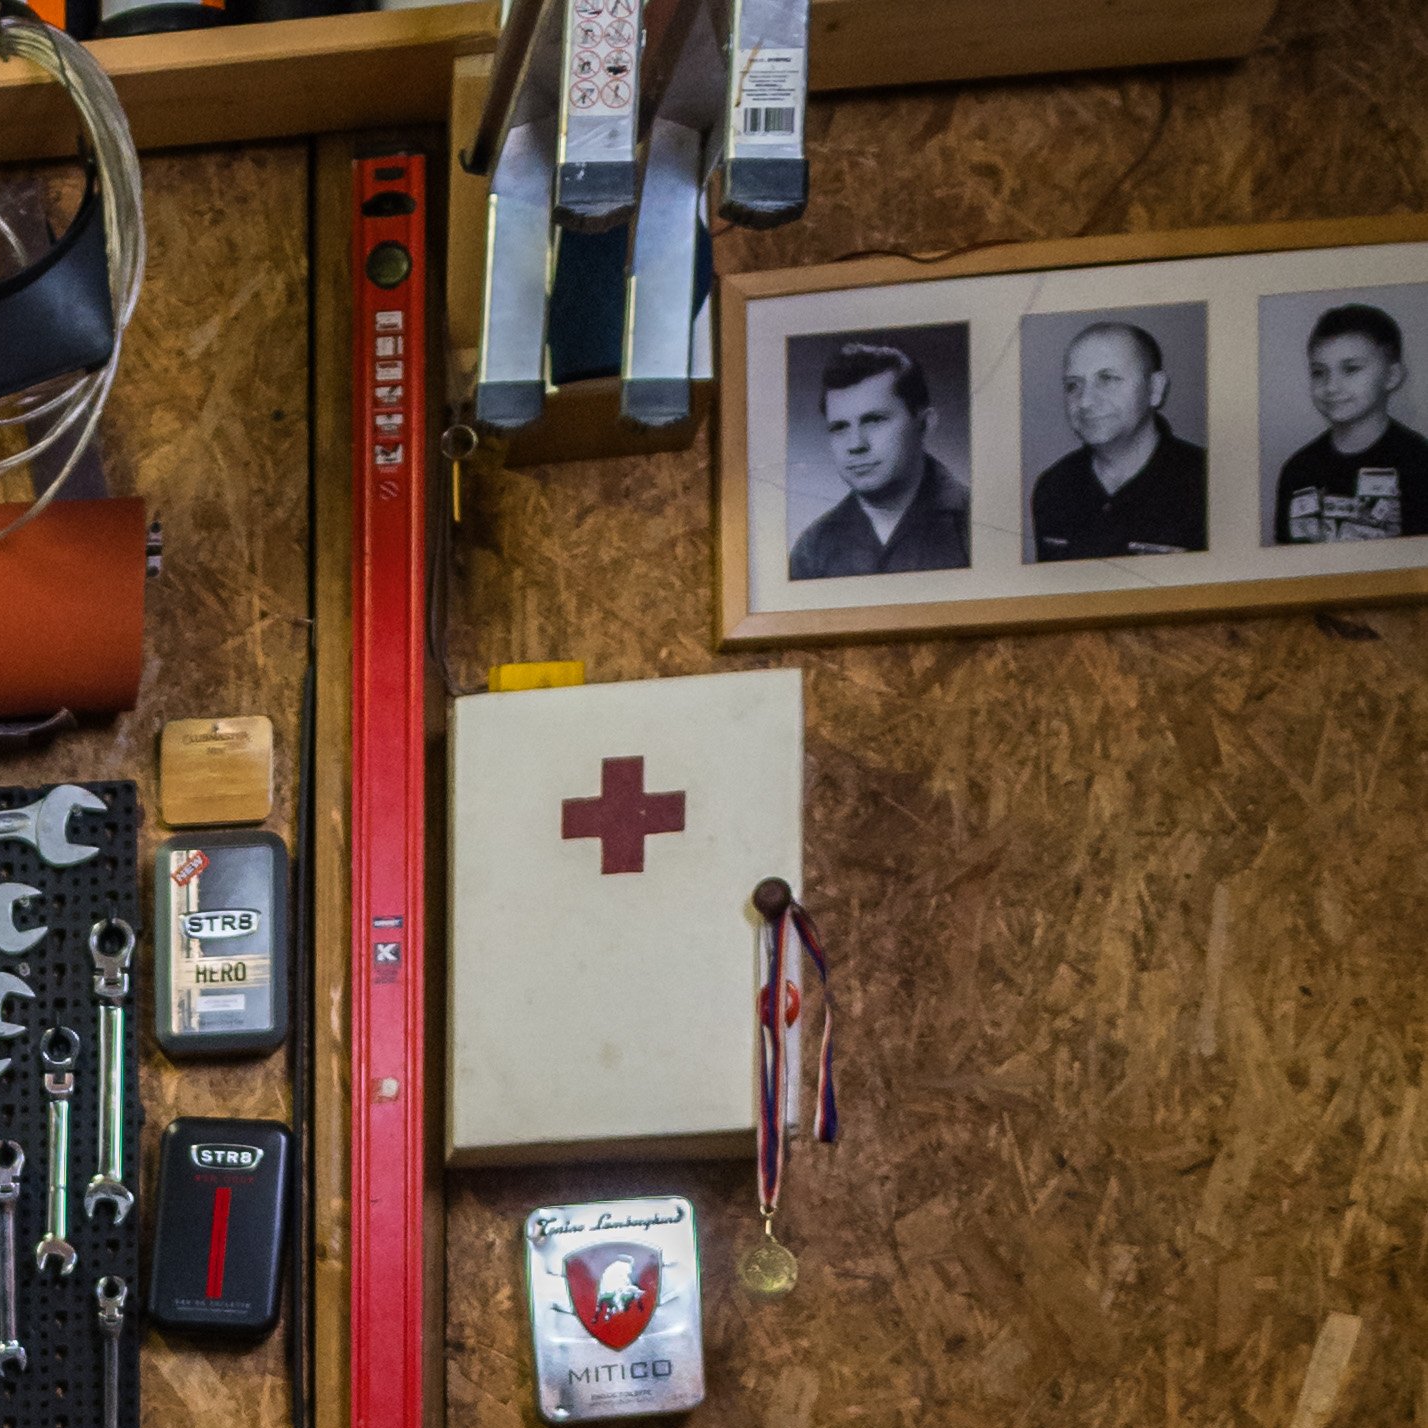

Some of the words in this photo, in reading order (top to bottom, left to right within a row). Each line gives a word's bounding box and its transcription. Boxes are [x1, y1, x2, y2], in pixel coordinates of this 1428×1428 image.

[176, 855, 204, 881] NEW
[187, 913, 253, 933] STR8
[195, 961, 247, 984] HERO
[200, 1150, 253, 1164] STR8
[568, 1359, 672, 1384] MITICO
